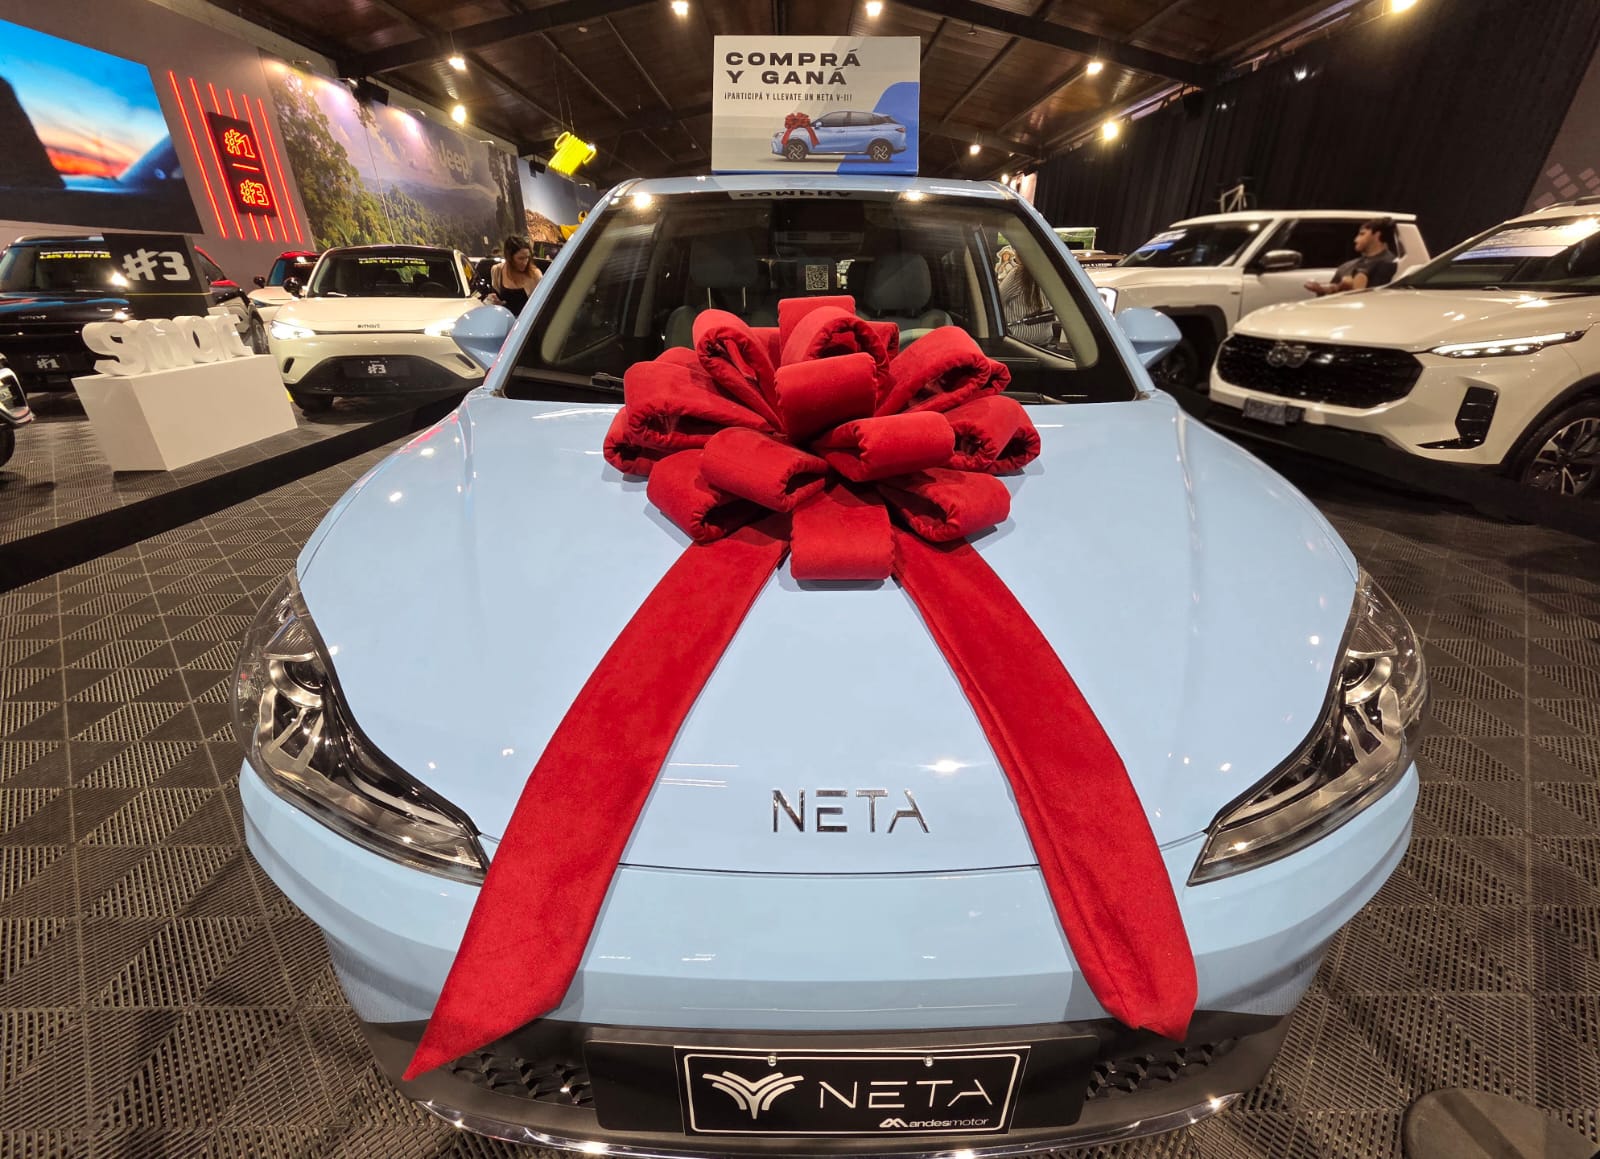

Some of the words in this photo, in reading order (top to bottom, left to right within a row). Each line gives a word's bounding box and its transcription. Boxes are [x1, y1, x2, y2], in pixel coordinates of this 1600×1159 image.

[726, 48, 861, 67] COMPRÁ
[726, 71, 745, 84] Y
[761, 67, 848, 85] GANÁ
[766, 92, 770, 100] Y
[772, 93, 802, 101] LLEVATE
[805, 93, 814, 101] UN
[816, 93, 834, 101] NETA
[224, 129, 256, 159] #1
[240, 179, 270, 206] #3
[121, 248, 191, 281] #3
[771, 788, 931, 834] NETA
[818, 1078, 994, 1110] NETA
